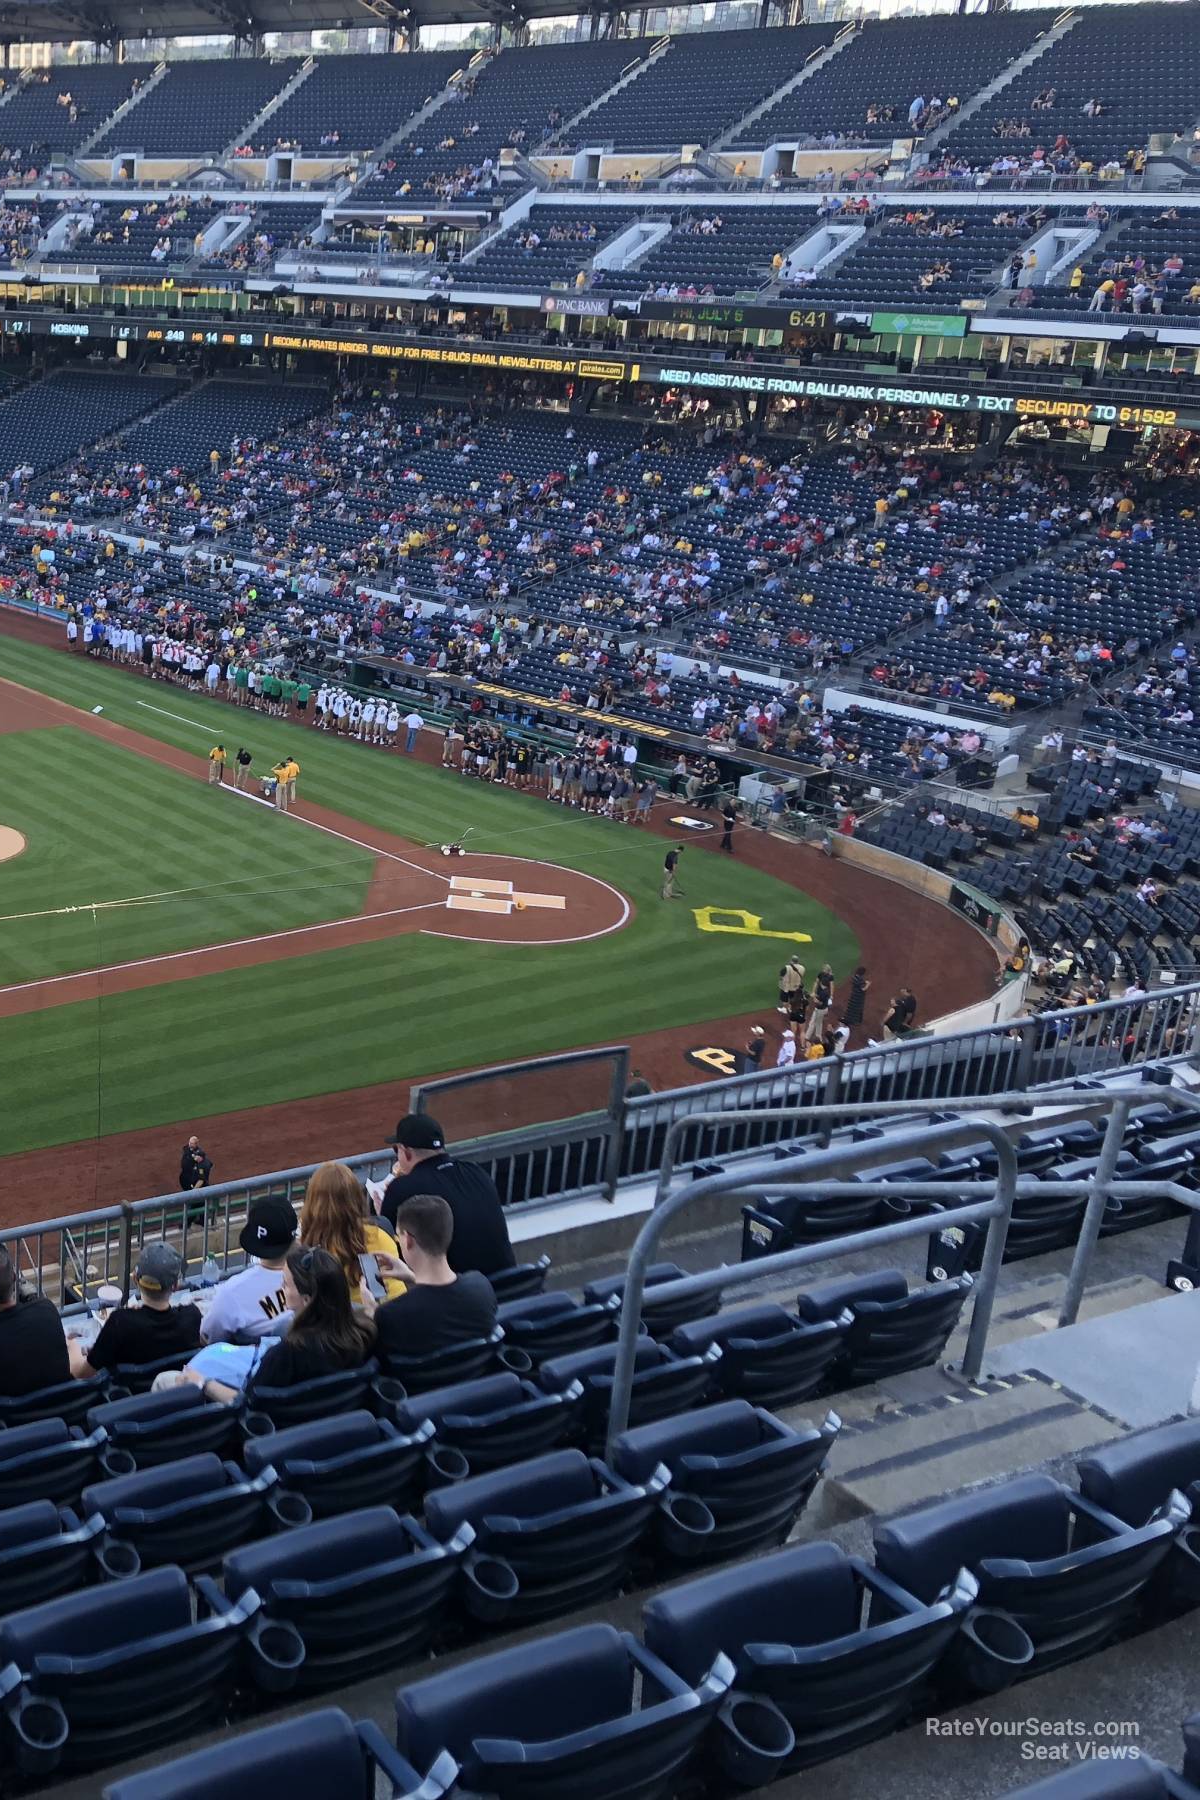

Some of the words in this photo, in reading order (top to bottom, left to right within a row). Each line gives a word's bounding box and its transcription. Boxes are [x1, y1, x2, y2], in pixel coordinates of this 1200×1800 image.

[556, 299, 578, 311] PNC
[578, 301, 605, 313] BANK
[697, 309, 730, 321] JULY
[789, 311, 827, 328] 6:41
[12, 322, 23, 331] 17
[51, 323, 89, 336] HOSKINS
[119, 327, 130, 337] LF
[147, 330, 162, 340] AVG
[192, 332, 203, 342] HR
[206, 332, 217, 343] 14
[222, 334, 235, 344] RBI
[240, 334, 253, 345] 53
[272, 336, 302, 347] BECOME
[302, 338, 308, 348] A
[308, 338, 338, 350] PIRATES
[372, 344, 391, 355] SIGN
[392, 346, 403, 356] UP
[404, 347, 420, 358] FOR
[421, 349, 440, 360] FREE
[442, 351, 471, 362] E-BUCS
[472, 353, 498, 365] EMAIL
[499, 355, 562, 371] NEWSLETTERS
[563, 361, 576, 372] AT
[582, 364, 622, 375] pirates.com
[660, 369, 692, 383] NEED
[692, 373, 766, 390] ASSISTANCE
[767, 378, 804, 394] FROM
[806, 384, 875, 400] BALLPARK
[877, 386, 970, 408] PERSONNEL?
[977, 395, 1014, 411] TEXT
[1016, 398, 1093, 418] SECURITY
[1095, 404, 1116, 420] TO
[1119, 407, 1177, 425] 61592
[576, 709, 671, 737] WELCOME
[257, 1225, 268, 1239] P
